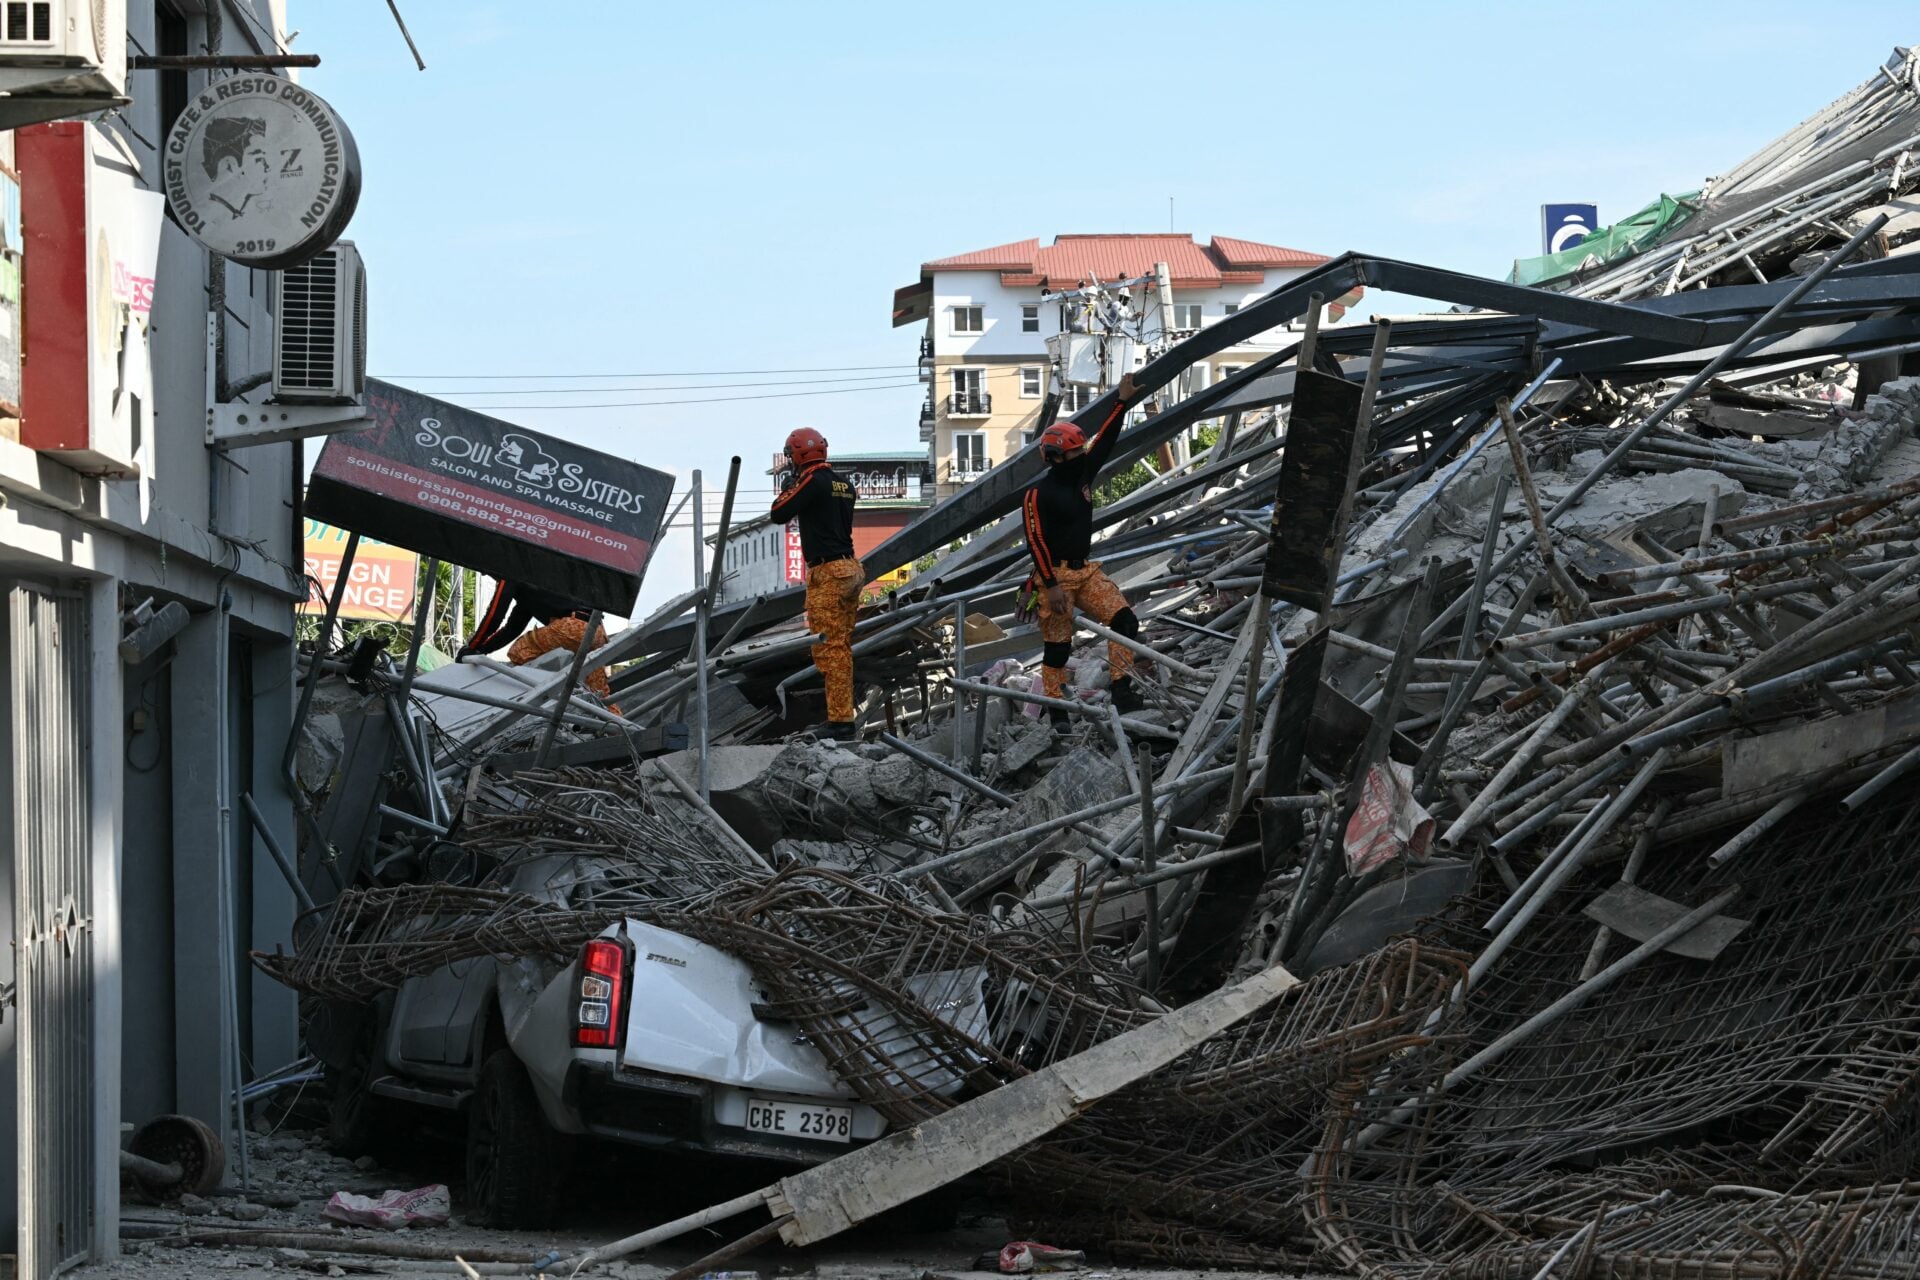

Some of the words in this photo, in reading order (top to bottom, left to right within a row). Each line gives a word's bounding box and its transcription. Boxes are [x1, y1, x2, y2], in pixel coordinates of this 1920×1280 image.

[200, 95, 216, 110] &
[215, 78, 277, 101] RESTO
[170, 107, 203, 155] CAFE
[280, 85, 339, 229] COMMUNICATION
[167, 158, 206, 235] TOURIST
[236, 238, 276, 253] 2019
[346, 456, 628, 551] soulsisterssalonandspa@gmail.com
[430, 457, 482, 479] SALON
[480, 474, 512, 489] AND
[515, 484, 541, 500] SPA
[545, 493, 615, 523] MASSAGE
[417, 491, 549, 539] 0908.888.2263
[304, 558, 391, 585] REGN
[646, 953, 687, 968] STRADA
[749, 1107, 786, 1131] CBE
[799, 1112, 849, 1136] 2398
